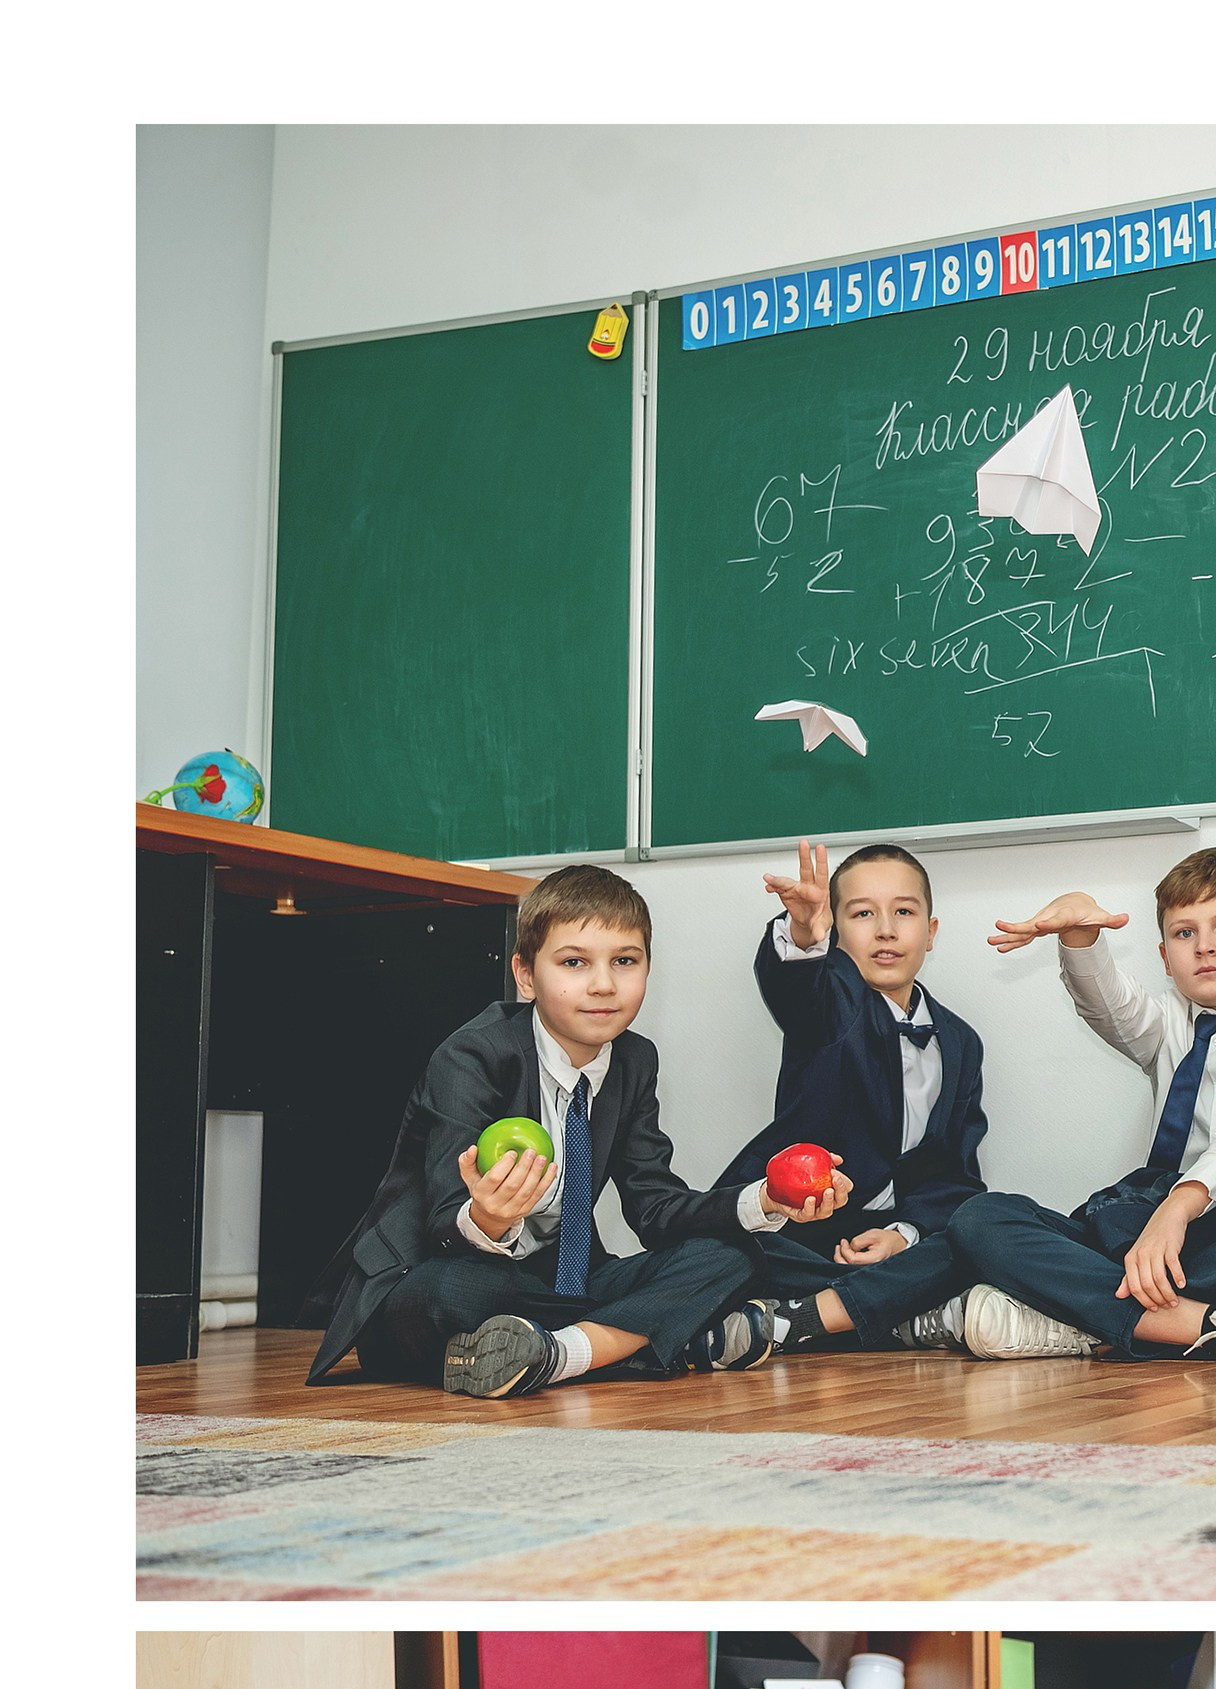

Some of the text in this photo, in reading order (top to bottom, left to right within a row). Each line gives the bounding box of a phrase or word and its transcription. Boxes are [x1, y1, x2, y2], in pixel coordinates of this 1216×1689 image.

[689, 301, 710, 340] 0
[722, 296, 736, 334] 1
[752, 290, 770, 330] 2
[783, 285, 800, 324] 3
[813, 279, 833, 317] 4
[845, 273, 863, 314] 5
[877, 266, 896, 307] 6
[909, 261, 927, 302] 7
[940, 255, 961, 295] 8
[974, 250, 994, 290] 9
[1003, 242, 1035, 285] 10
[1041, 236, 1071, 278] 11
[1080, 228, 1112, 272] 12
[1118, 221, 1151, 264] 13
[1157, 214, 1192, 257] 14
[946, 286, 1213, 384] 29 ноября
[754, 463, 889, 549] 67
[796, 635, 1007, 684] six seven
[991, 710, 1061, 757] 52
